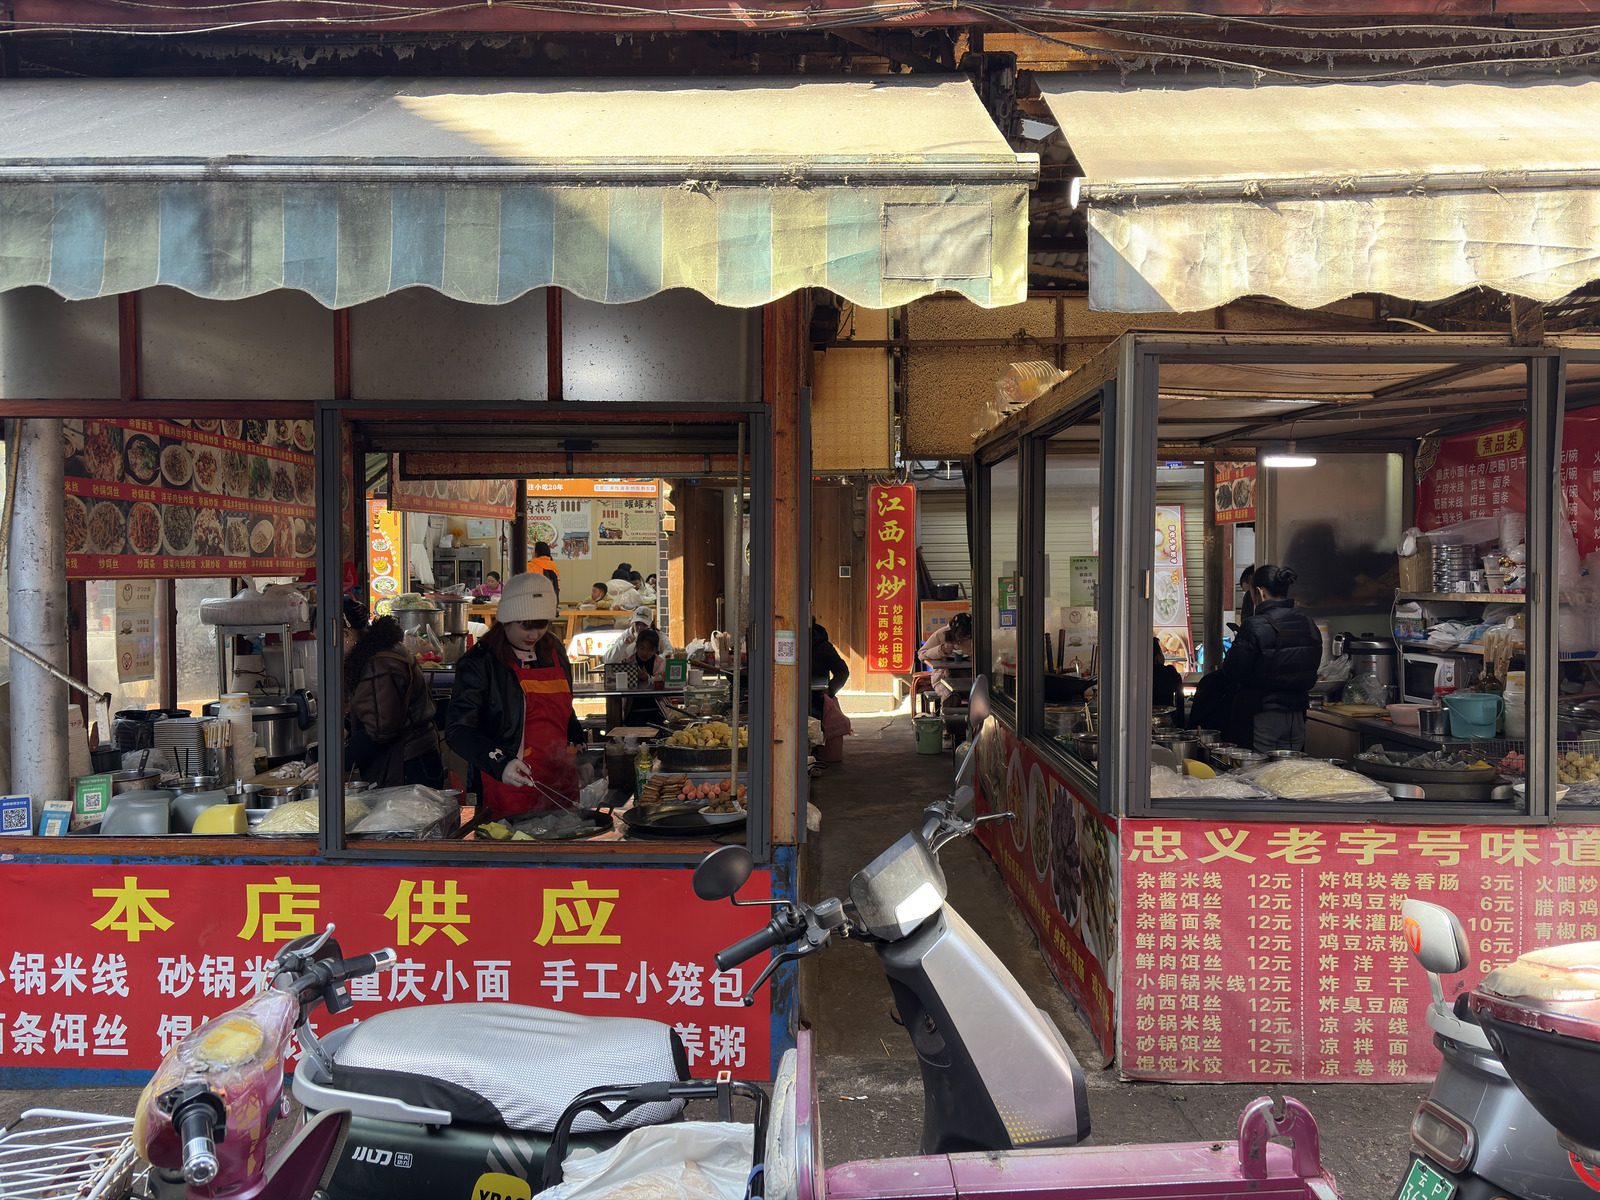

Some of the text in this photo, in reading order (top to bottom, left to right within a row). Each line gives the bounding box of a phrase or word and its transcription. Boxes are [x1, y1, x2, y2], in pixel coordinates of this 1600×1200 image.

[1482, 431, 1518, 455] 煮品类
[624, 500, 656, 510] 罐罐米
[875, 491, 907, 600] 江西小炒
[878, 605, 888, 668] 江西炒米粉
[1128, 826, 1600, 867] 忠义老字号味道
[1136, 872, 1222, 889] 杂酱米线
[1247, 874, 1292, 889] 12元
[1318, 872, 1460, 890] 炸饵块卷香肠
[1480, 875, 1514, 891] 3元
[91, 876, 621, 947] 本店供应
[1136, 892, 1222, 910] 杂酱饵丝
[1247, 894, 1292, 910] 12元
[1318, 893, 1408, 910] 炸鸡豆粉
[1480, 896, 1514, 913] 6元
[1136, 913, 1222, 930] 杂酱面条
[1247, 914, 1292, 930] 12元
[1468, 917, 1514, 934] 10元
[1136, 933, 1514, 954] 鲜肉米线 12元 鸡豆凉粉 6元
[1136, 953, 1222, 971] 鲜肉饵丝
[1247, 956, 1292, 972] 12元
[350, 958, 511, 1002] 重庆小面
[540, 958, 747, 1007] 手工小笼包
[1136, 974, 1246, 992] 小铜锅米线
[1247, 976, 1292, 992] 12元
[1136, 994, 1408, 1014] 纳西饵丝 12元 炸臭豆腐
[0, 1011, 129, 1057] 条饵丝
[1136, 1014, 1222, 1032] 砂锅米线
[1247, 1018, 1292, 1034] 12元
[1136, 1035, 1222, 1052] 砂锅饵丝
[1247, 1038, 1292, 1055] 12元
[1136, 1056, 1222, 1074] 馄饨水饺
[1247, 1059, 1292, 1075] 12元
